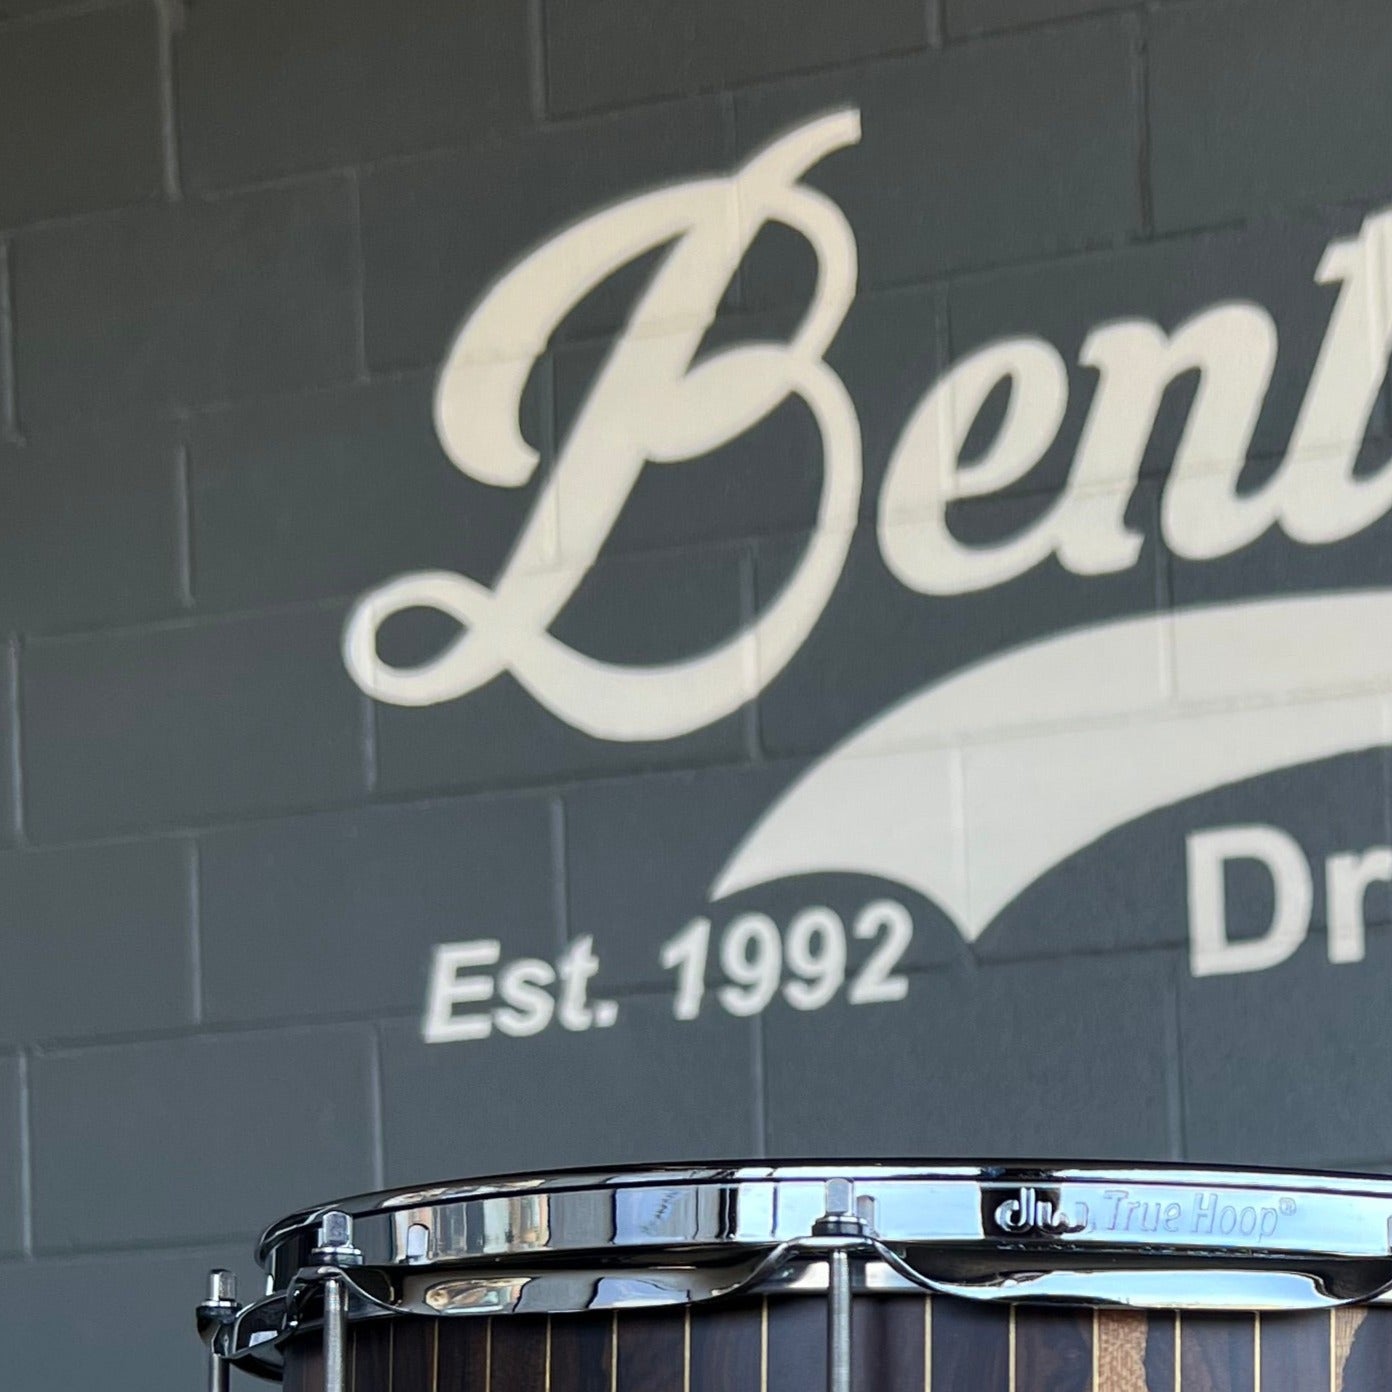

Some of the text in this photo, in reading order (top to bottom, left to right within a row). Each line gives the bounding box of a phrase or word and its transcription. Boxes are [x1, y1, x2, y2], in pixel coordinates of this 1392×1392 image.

[422, 902, 913, 1044] Est. 1992
[1103, 1190, 1181, 1232] True
